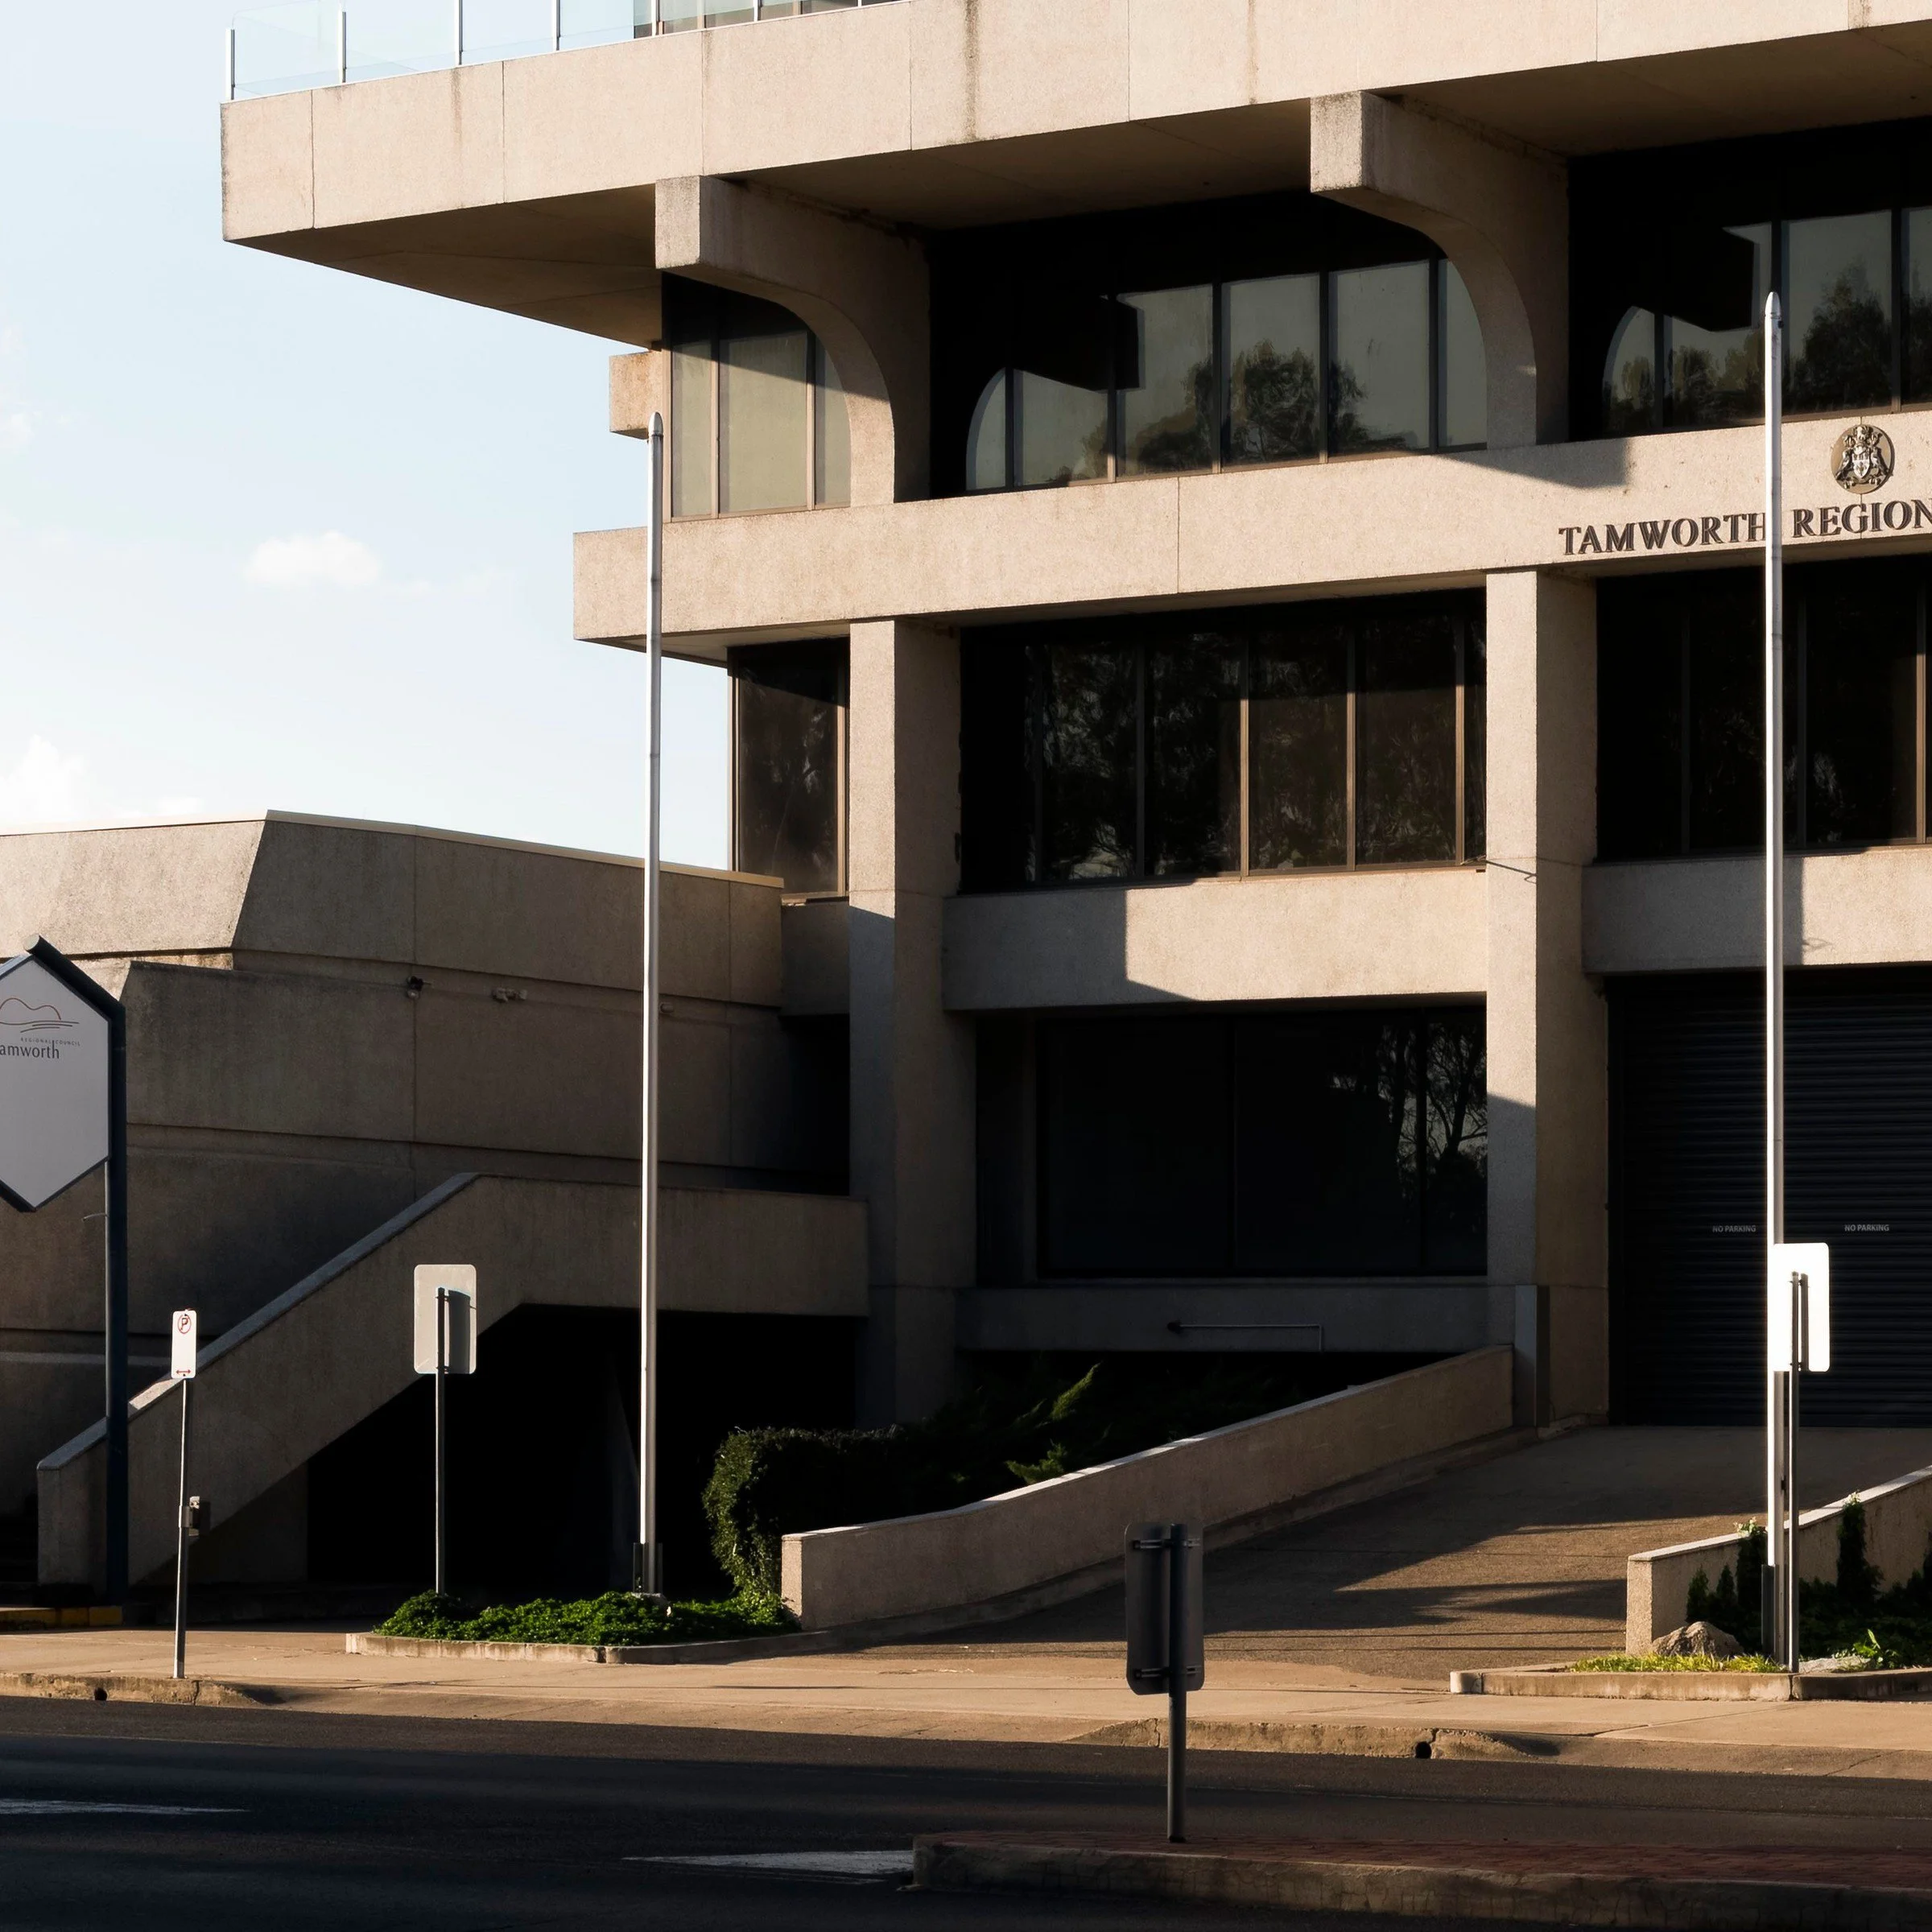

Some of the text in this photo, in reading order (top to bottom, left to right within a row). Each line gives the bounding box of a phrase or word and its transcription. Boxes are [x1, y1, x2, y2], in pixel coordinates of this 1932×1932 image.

[1558, 498, 1932, 556] TAMWORTH REGION
[21, 1037, 52, 1045] REGIONAL
[0, 1039, 60, 1059] amworth
[1712, 1224, 1757, 1232] NO PARKING
[1844, 1224, 1890, 1232] NO PARKING
